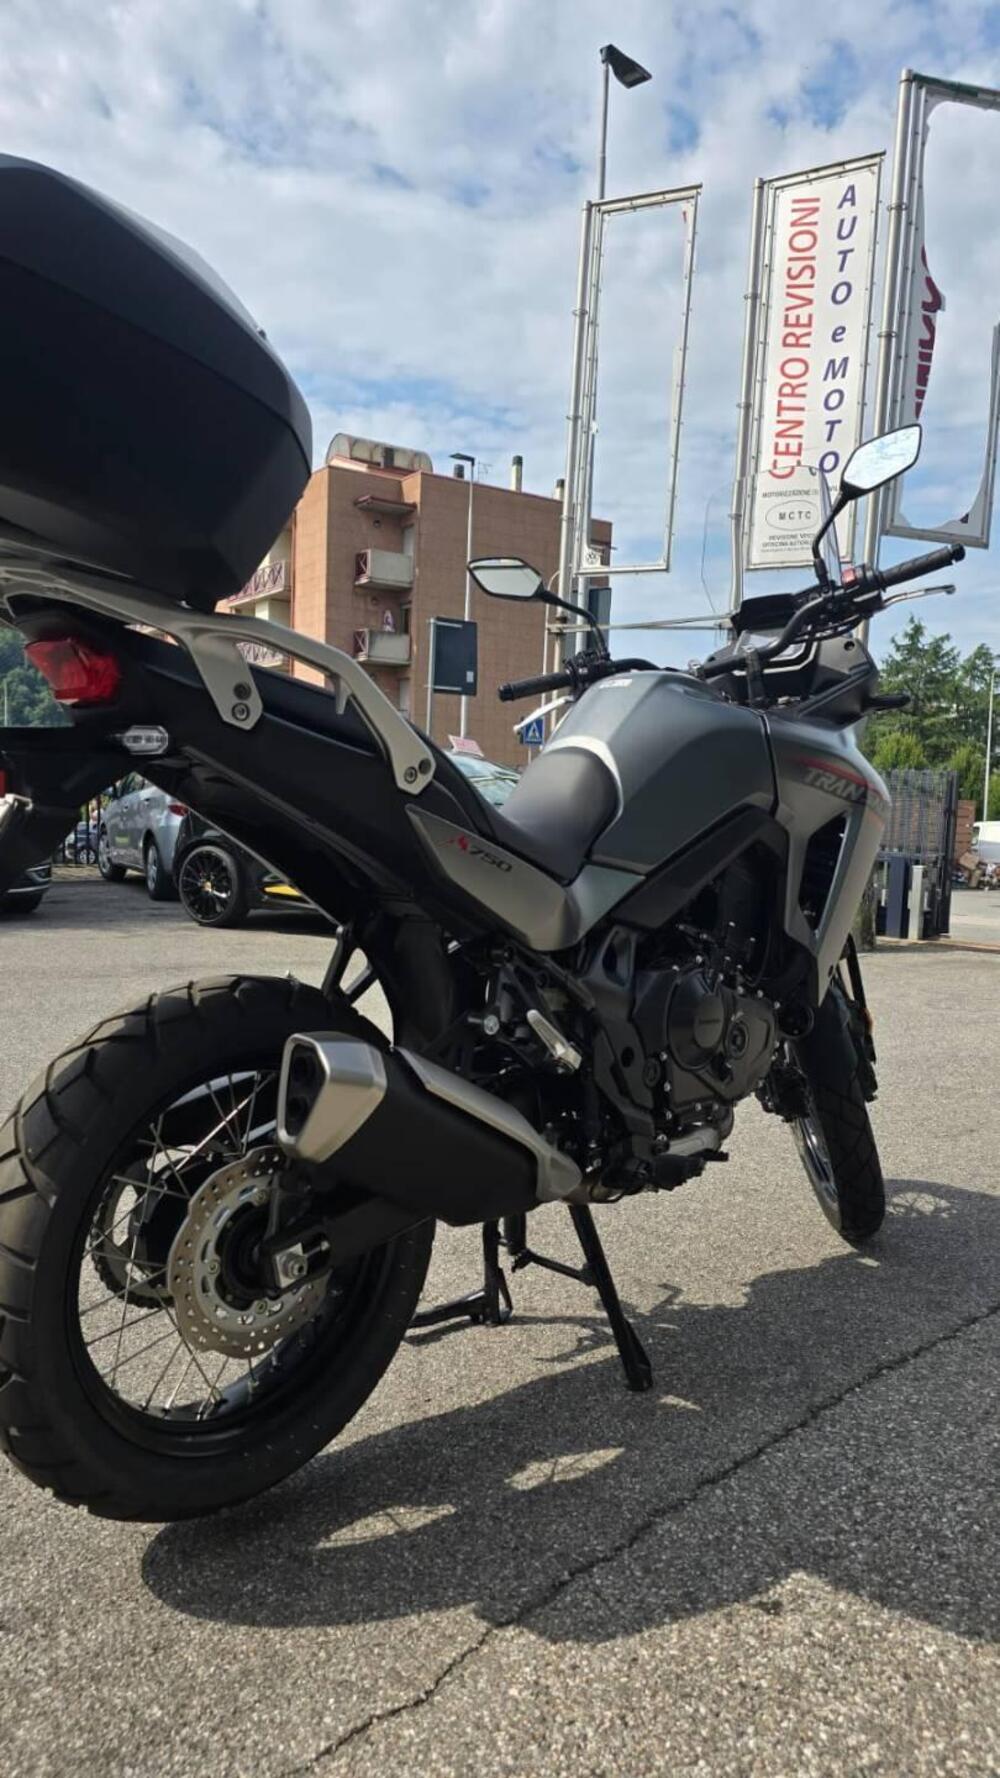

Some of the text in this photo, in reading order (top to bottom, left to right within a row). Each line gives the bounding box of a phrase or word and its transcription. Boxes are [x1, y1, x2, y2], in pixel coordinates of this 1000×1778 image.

[769, 197, 821, 480] CENTRO REVISIONI
[818, 184, 857, 474] AUTO e MOTO
